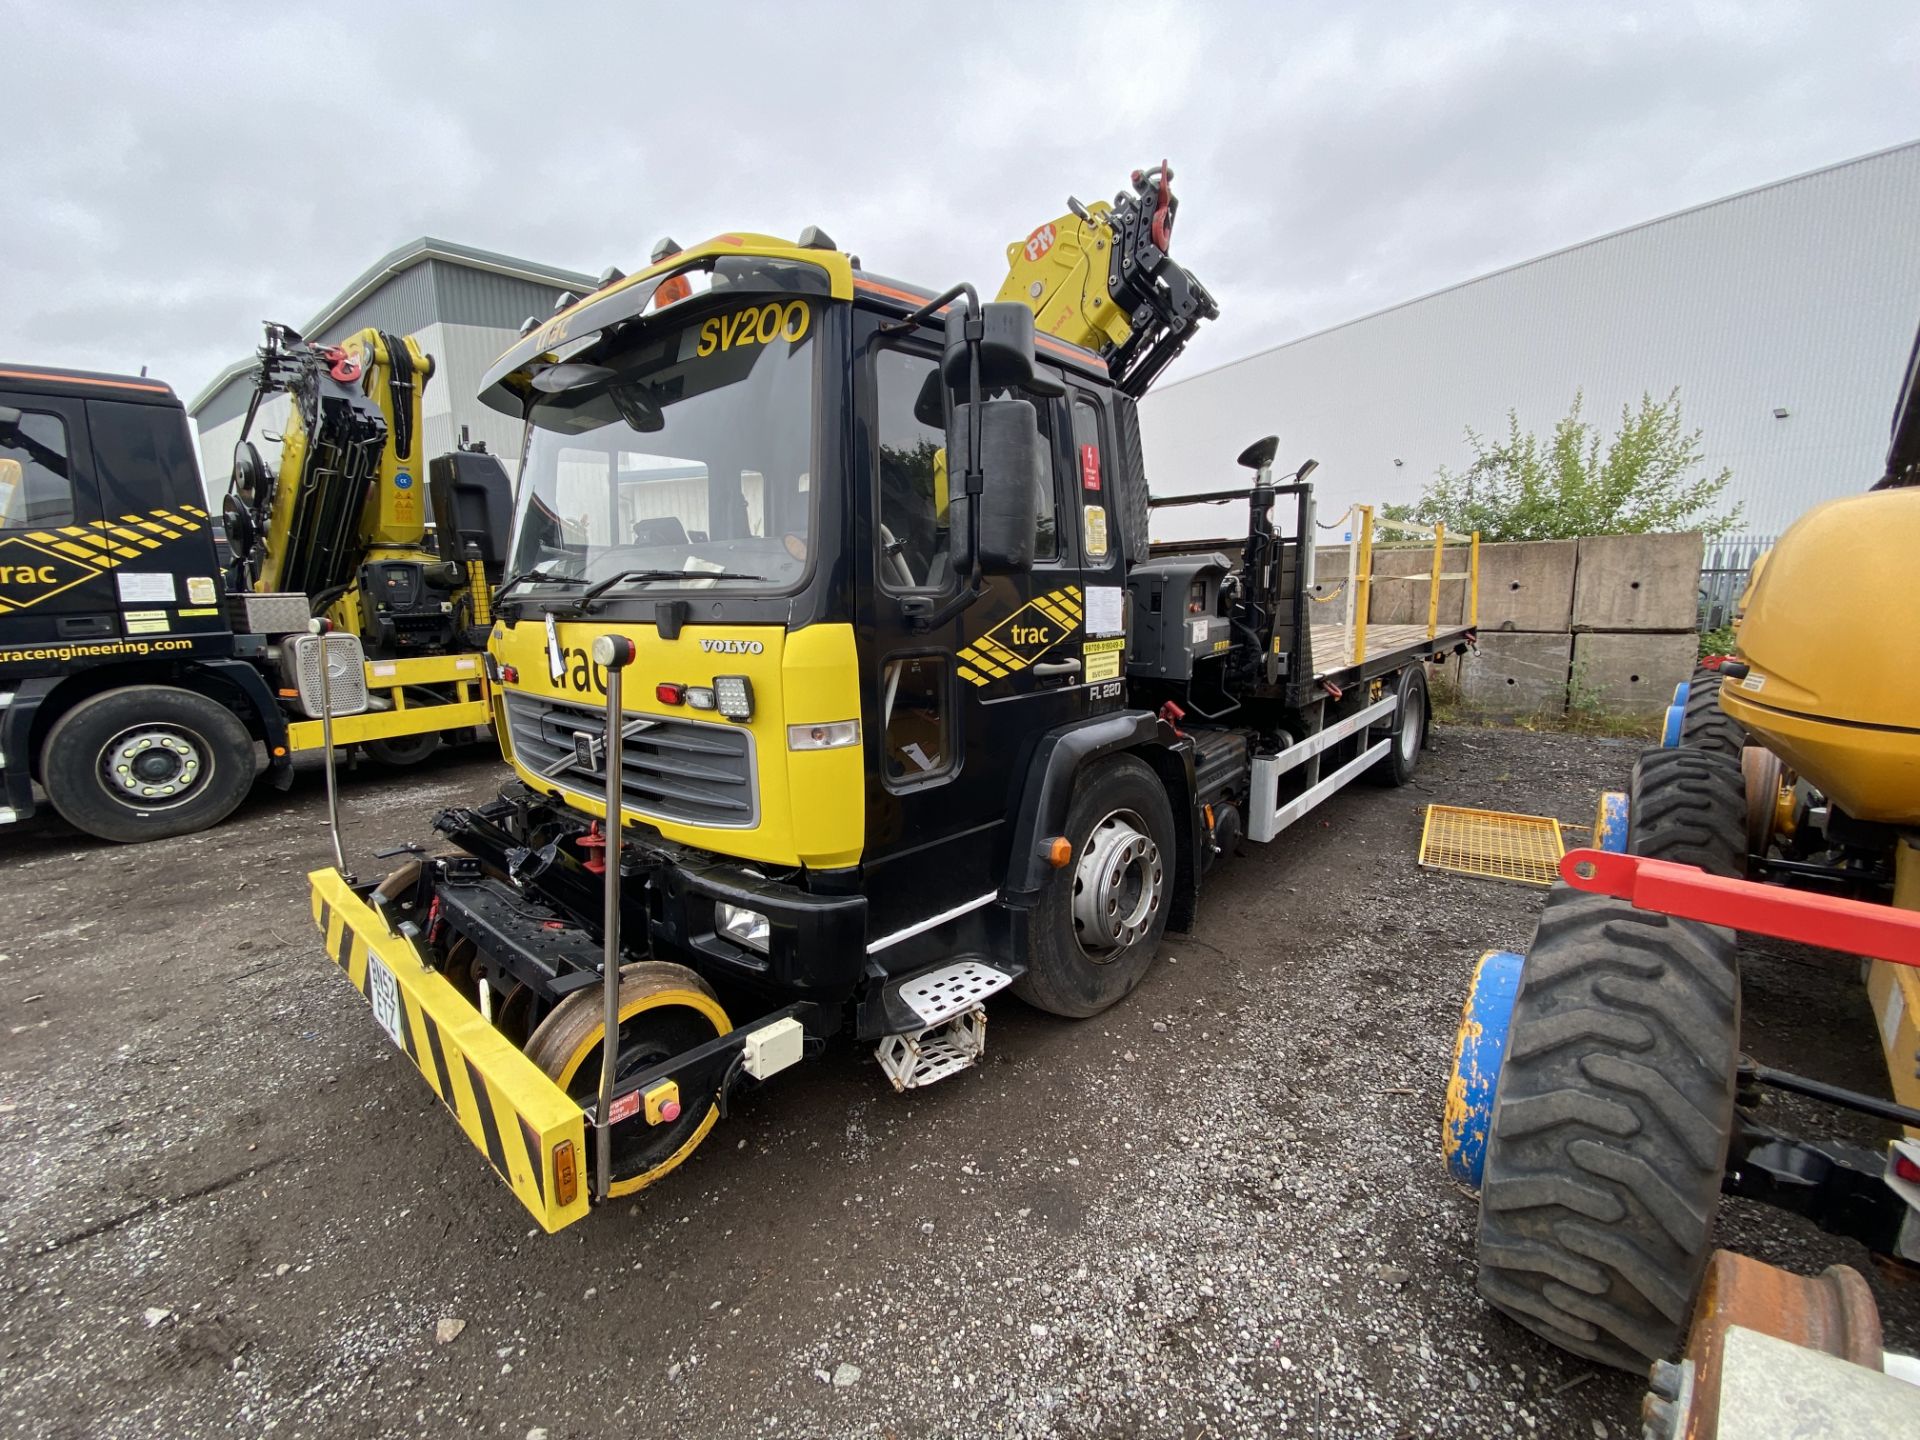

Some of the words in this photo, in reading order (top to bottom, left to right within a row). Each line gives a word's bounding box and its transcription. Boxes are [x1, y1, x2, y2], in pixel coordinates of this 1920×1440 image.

[1027, 225, 1054, 260] PM
[697, 300, 810, 356] SV200
[0, 566, 57, 584] rac
[1011, 624, 1049, 645] trac
[700, 639, 763, 655] VOLVO
[1090, 686, 1102, 701] FL
[1103, 682, 1121, 698] 220
